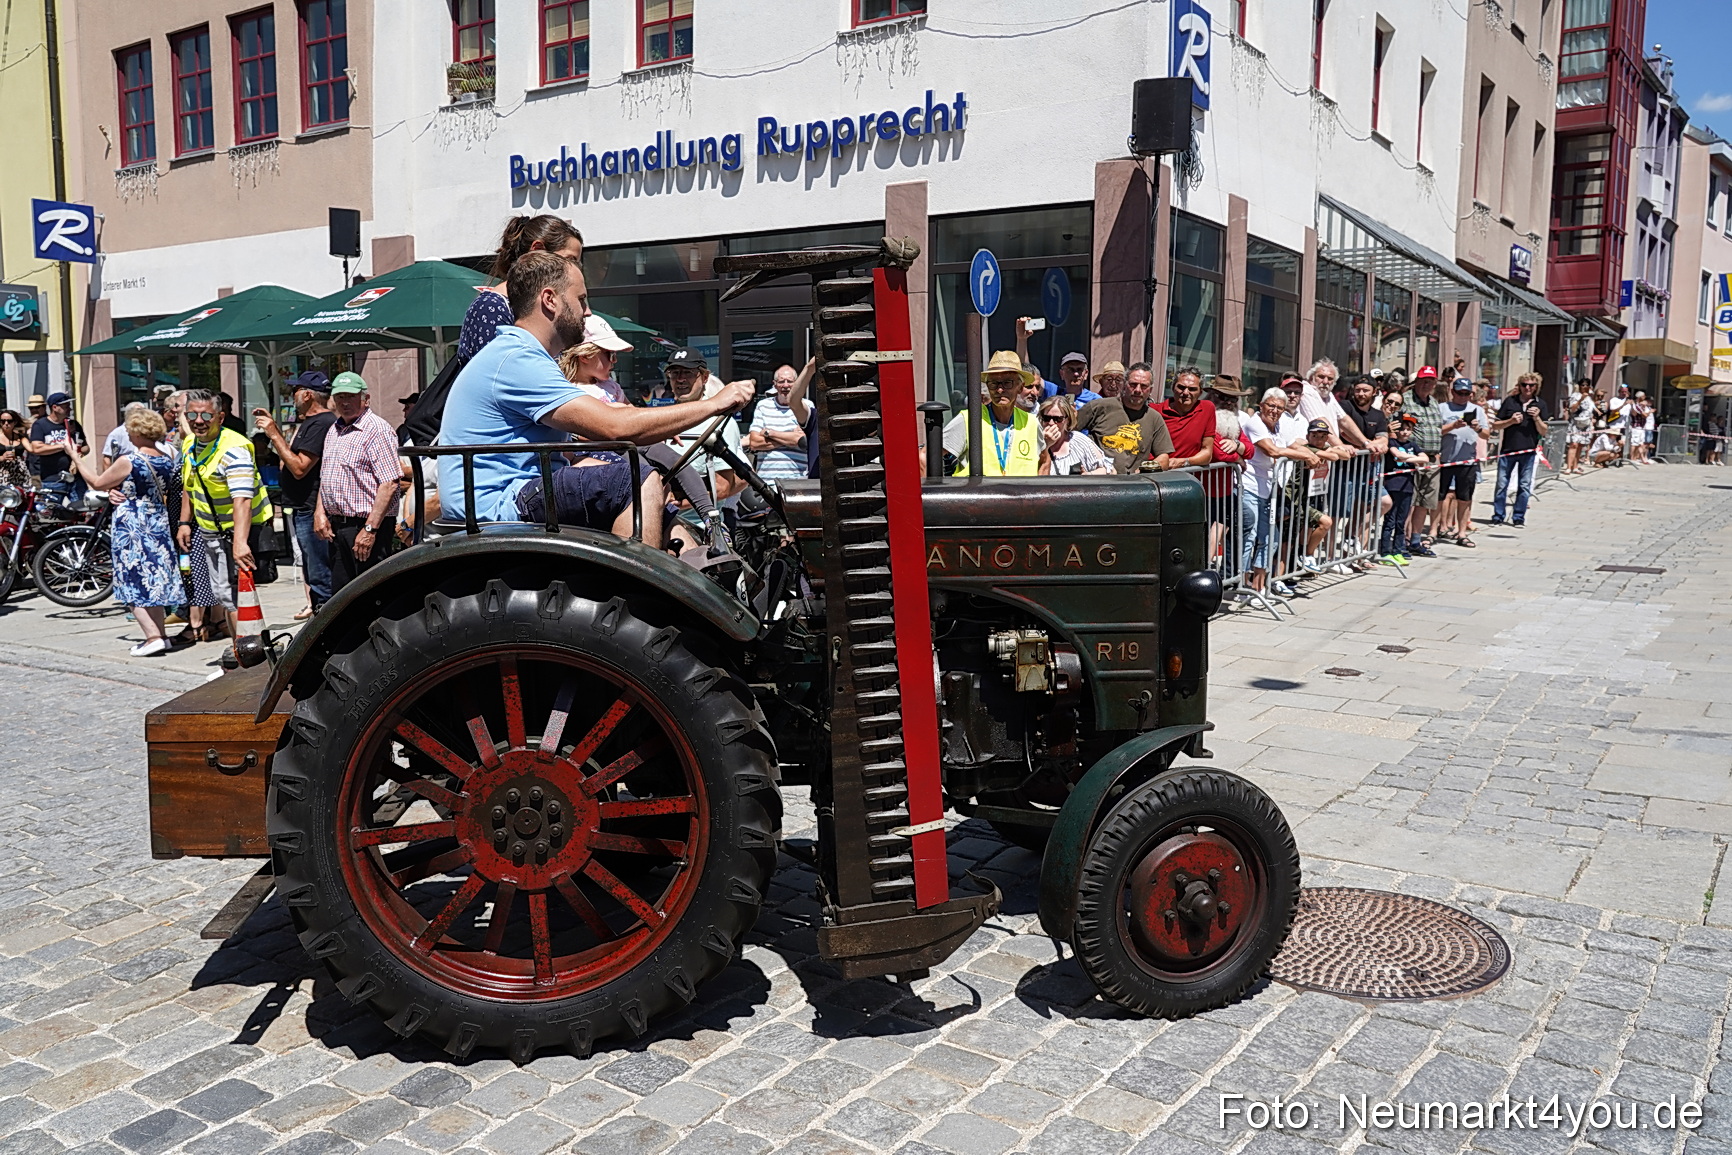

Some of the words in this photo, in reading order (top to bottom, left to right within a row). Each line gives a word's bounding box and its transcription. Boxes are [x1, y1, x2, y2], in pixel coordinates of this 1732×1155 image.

[510, 129, 744, 189] Buchhandlung
[757, 89, 969, 161] Rupprecht
[103, 281, 121, 291] Unterer
[123, 279, 138, 289] Markt
[4, 298, 24, 321] G2
[926, 544, 1117, 569] ANOMAG
[1096, 642, 1112, 661] R
[1117, 641, 1140, 661] 19
